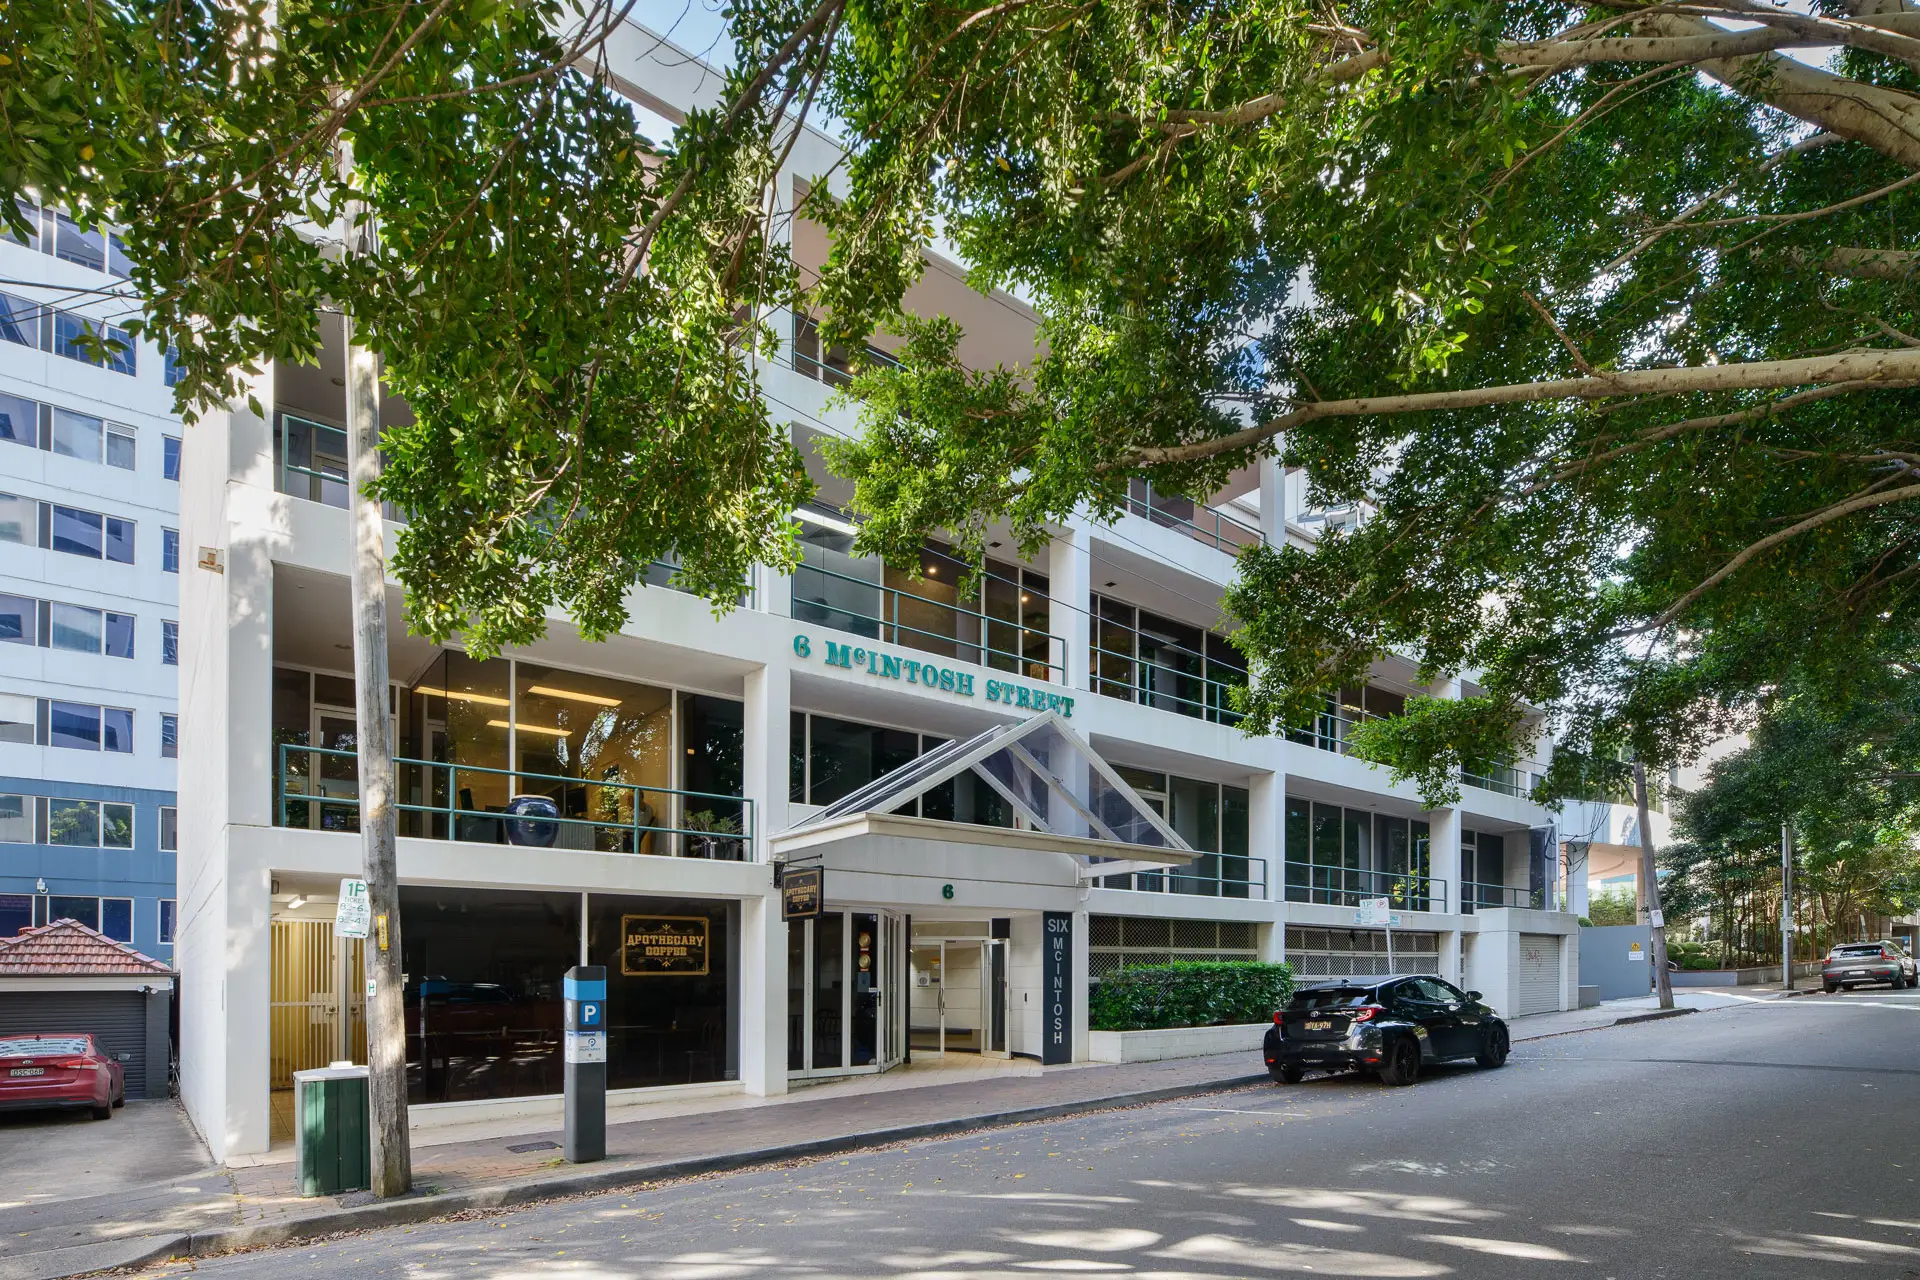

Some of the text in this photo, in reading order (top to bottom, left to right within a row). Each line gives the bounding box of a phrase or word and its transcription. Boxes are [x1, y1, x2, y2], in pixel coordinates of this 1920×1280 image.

[793, 634, 811, 658] 6
[986, 679, 1075, 718] STREET
[348, 882, 366, 896] 1P
[942, 884, 954, 900] 6
[1047, 918, 1069, 933] SIX
[626, 934, 705, 947] APOTHECARY
[645, 946, 687, 956] COFFEE
[1053, 937, 1063, 1044] MCINTOSH
[584, 1005, 597, 1022] P
